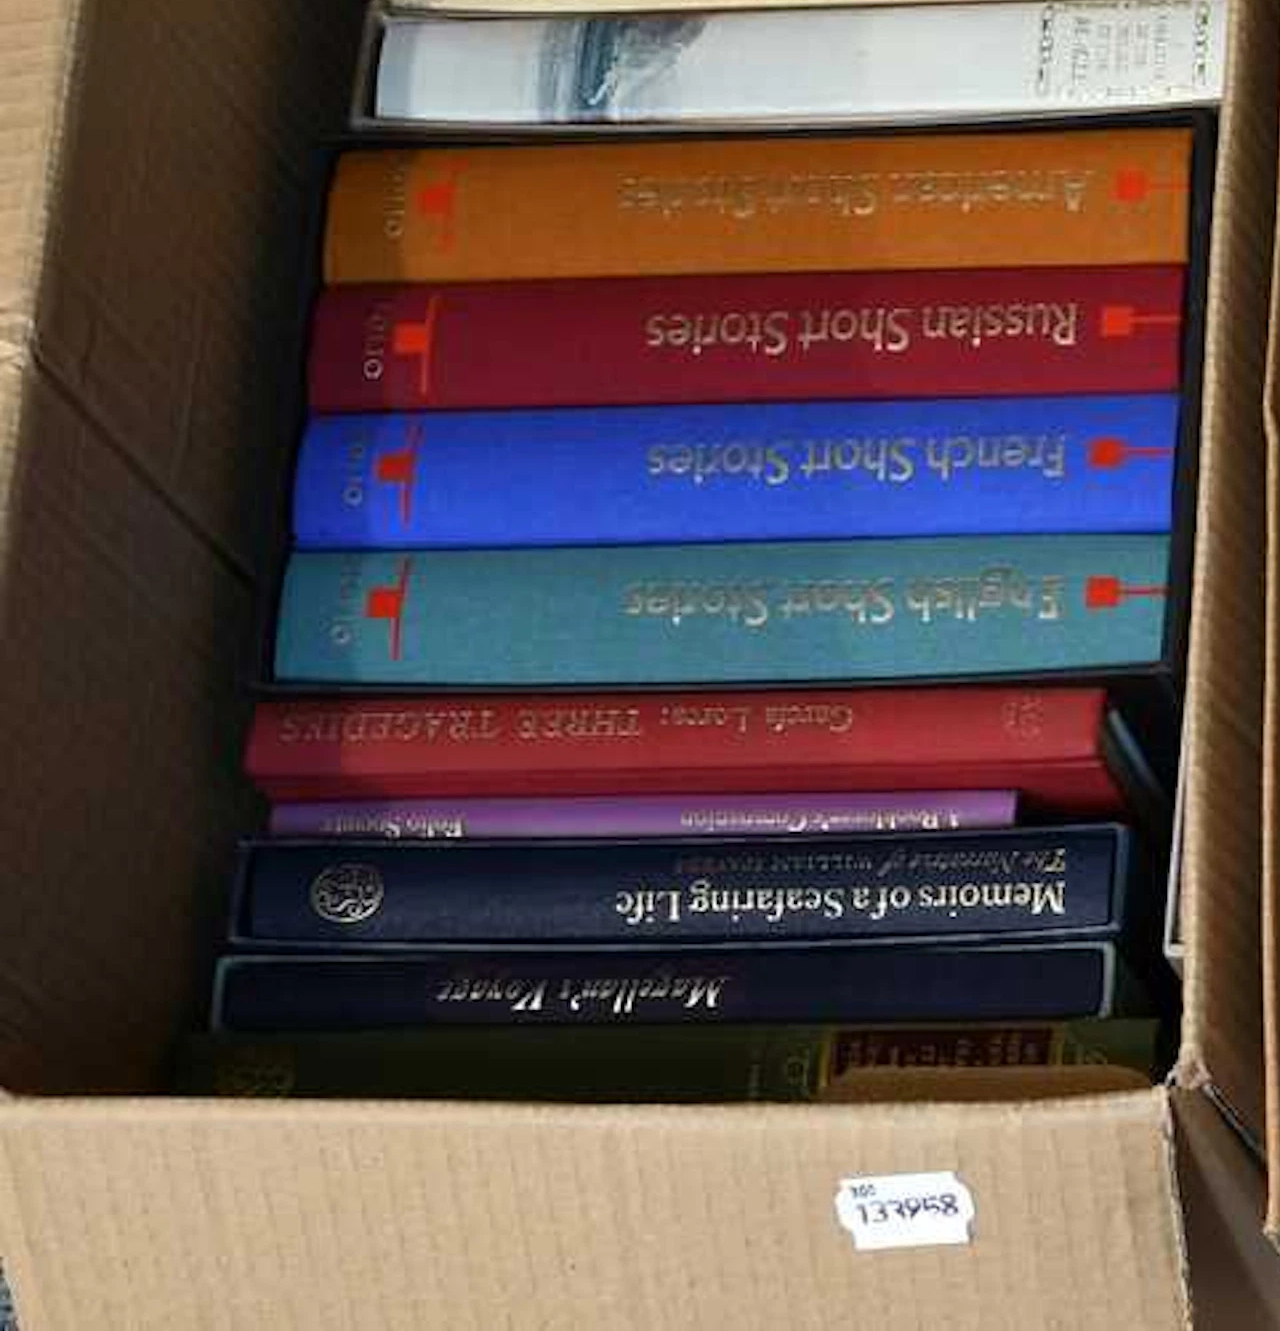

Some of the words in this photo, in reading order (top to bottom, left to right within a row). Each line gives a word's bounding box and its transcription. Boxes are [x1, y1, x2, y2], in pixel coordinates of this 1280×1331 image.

[644, 310, 788, 351] Stories
[800, 307, 911, 351] Short
[921, 301, 1078, 346] Russian
[644, 441, 790, 483] Stories
[800, 435, 913, 481] Short
[925, 434, 1067, 480] French
[622, 582, 768, 628] Stories
[779, 577, 894, 627] Short
[901, 567, 1065, 622] English
[615, 886, 680, 923] Life
[688, 884, 844, 919] Seafaring
[851, 894, 869, 917] a
[870, 884, 914, 918] of
[920, 879, 1066, 917] Memoirs
[435, 976, 545, 1012] Voyage
[562, 974, 732, 1010] Magellan's
[855, 1192, 959, 1225] 133958
